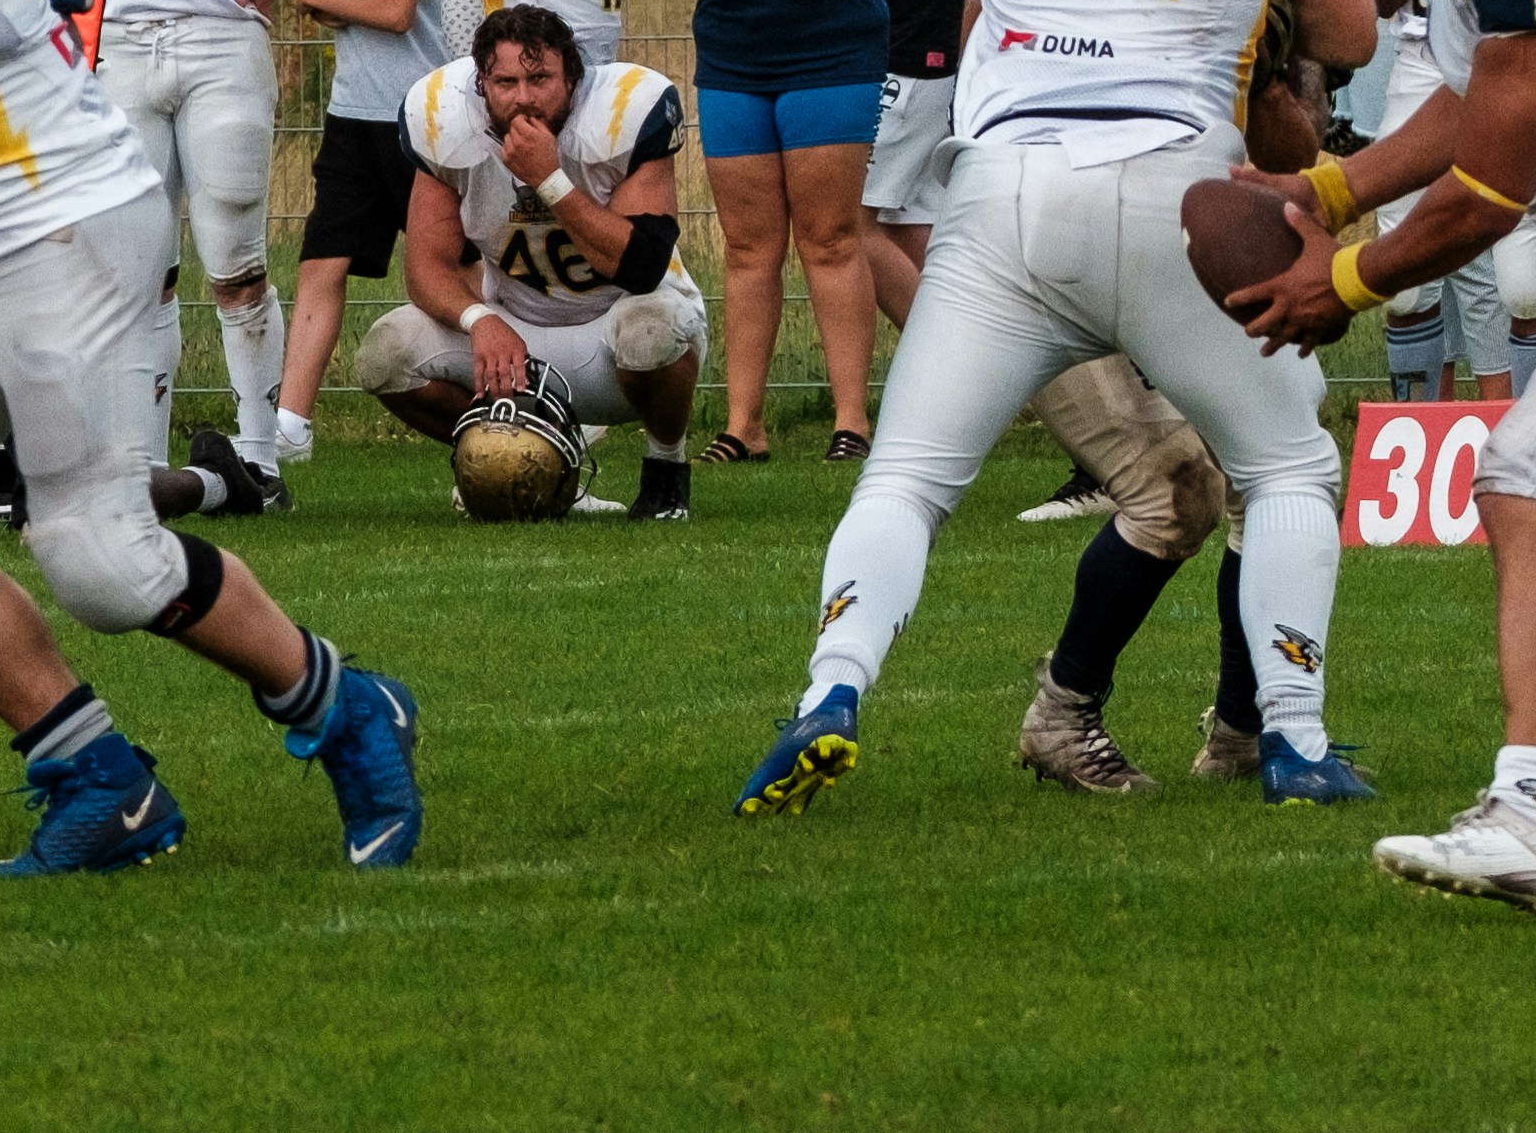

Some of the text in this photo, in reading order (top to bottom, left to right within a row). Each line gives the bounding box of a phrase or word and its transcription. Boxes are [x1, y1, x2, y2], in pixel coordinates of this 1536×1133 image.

[1041, 34, 1115, 58] DUMA
[498, 225, 613, 295] 46
[1359, 415, 1490, 547] 30
